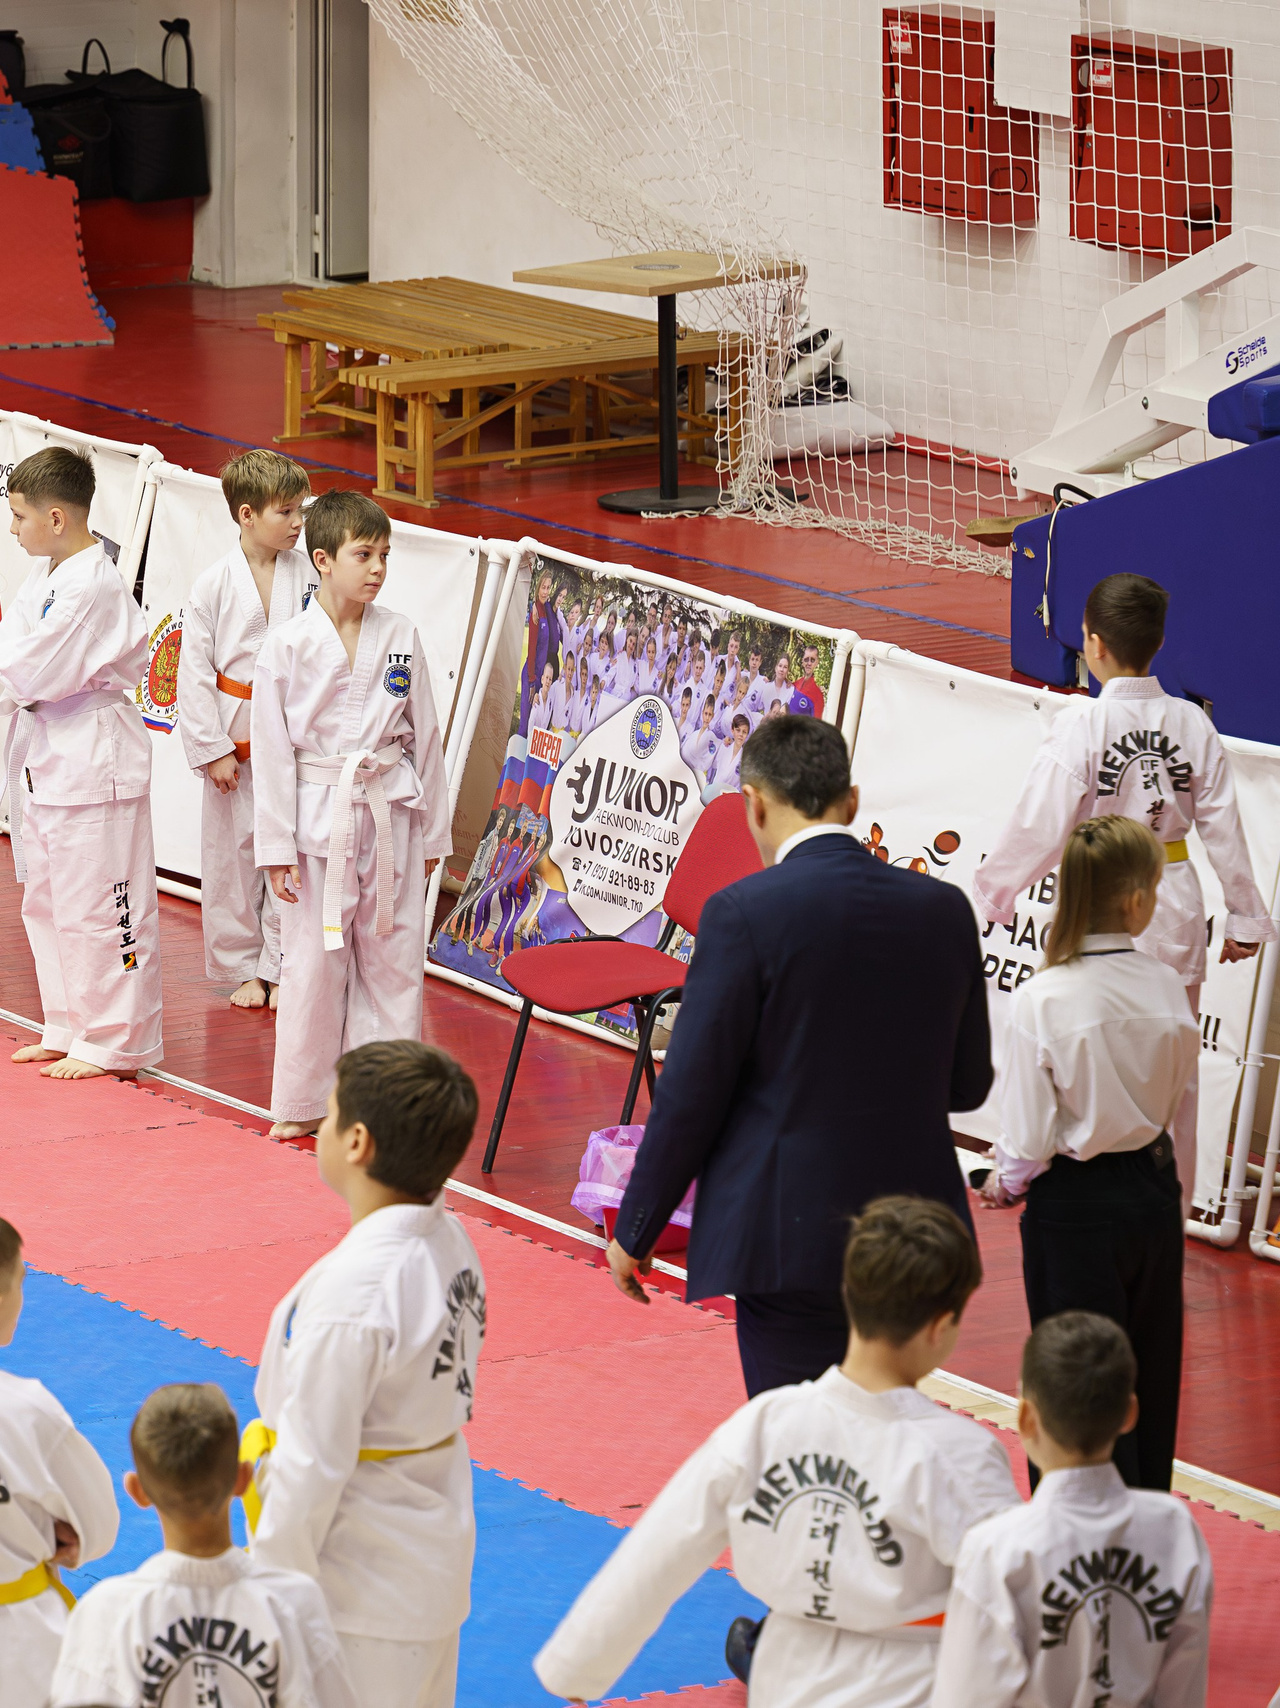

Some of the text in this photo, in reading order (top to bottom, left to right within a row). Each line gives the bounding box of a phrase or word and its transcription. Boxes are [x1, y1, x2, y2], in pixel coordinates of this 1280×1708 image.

[1238, 336, 1266, 357] Schelde
[1239, 346, 1267, 368] Sports
[307, 583, 319, 591] ITF
[151, 621, 183, 653] TAEKWO
[388, 653, 412, 664] ITF
[529, 728, 563, 768] ВПЕРЕД
[1140, 759, 1159, 771] ITF
[571, 757, 689, 825] JUNIOR
[592, 808, 680, 846] TAEKWON-DO CLUB
[561, 825, 678, 876] NOVOSIBIRSK
[113, 880, 130, 894] ITF
[583, 860, 593, 875] +7
[608, 869, 656, 896] 921-89-83
[115, 892, 136, 948] 태권도
[741, 1453, 904, 1568] TAEKWON-DO
[813, 1496, 847, 1517] ITF
